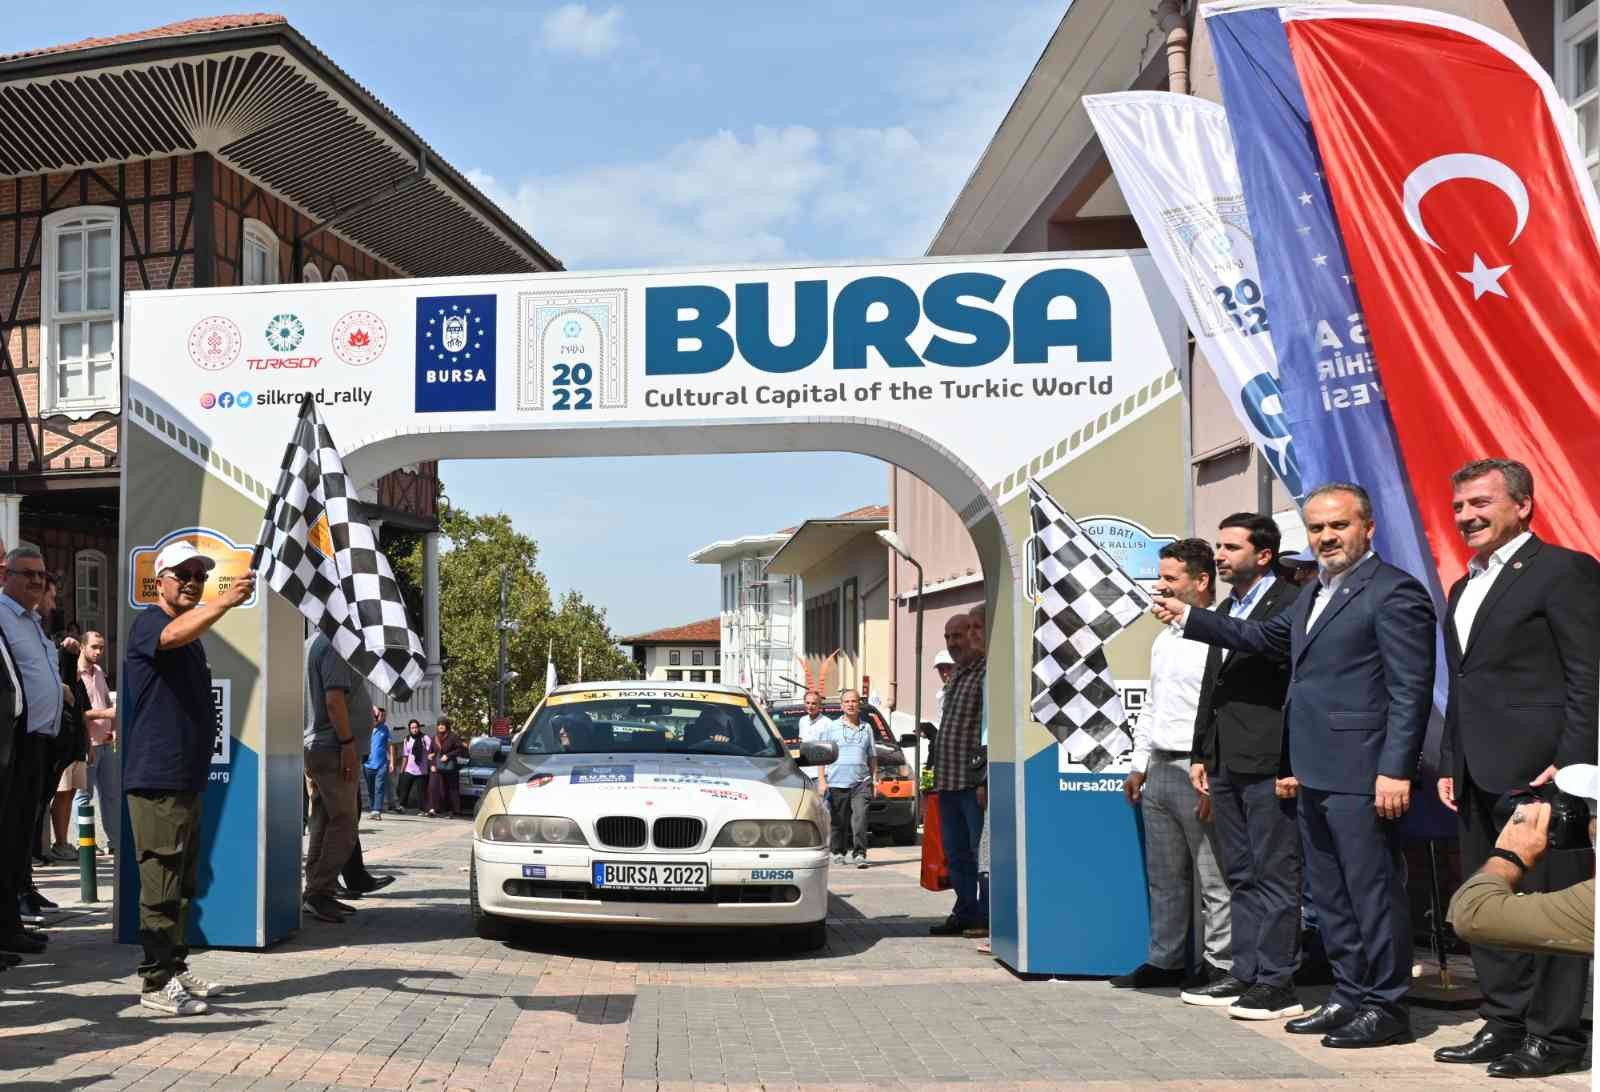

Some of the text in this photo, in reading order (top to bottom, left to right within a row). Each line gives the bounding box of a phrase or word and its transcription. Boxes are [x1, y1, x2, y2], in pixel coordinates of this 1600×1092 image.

[1213, 278, 1261, 311] 20
[645, 267, 1112, 376] BURSA
[427, 369, 486, 383] BURSA
[552, 363, 593, 386] 20
[257, 387, 372, 405] silkrod_rally
[552, 388, 593, 410] 22
[645, 375, 1112, 408] Cultural Capital of the Turkic World
[663, 691, 709, 700] RALLY
[1059, 779, 1124, 792] bursa202
[605, 864, 706, 885] BURSA 2022
[751, 869, 794, 880] BURSA
